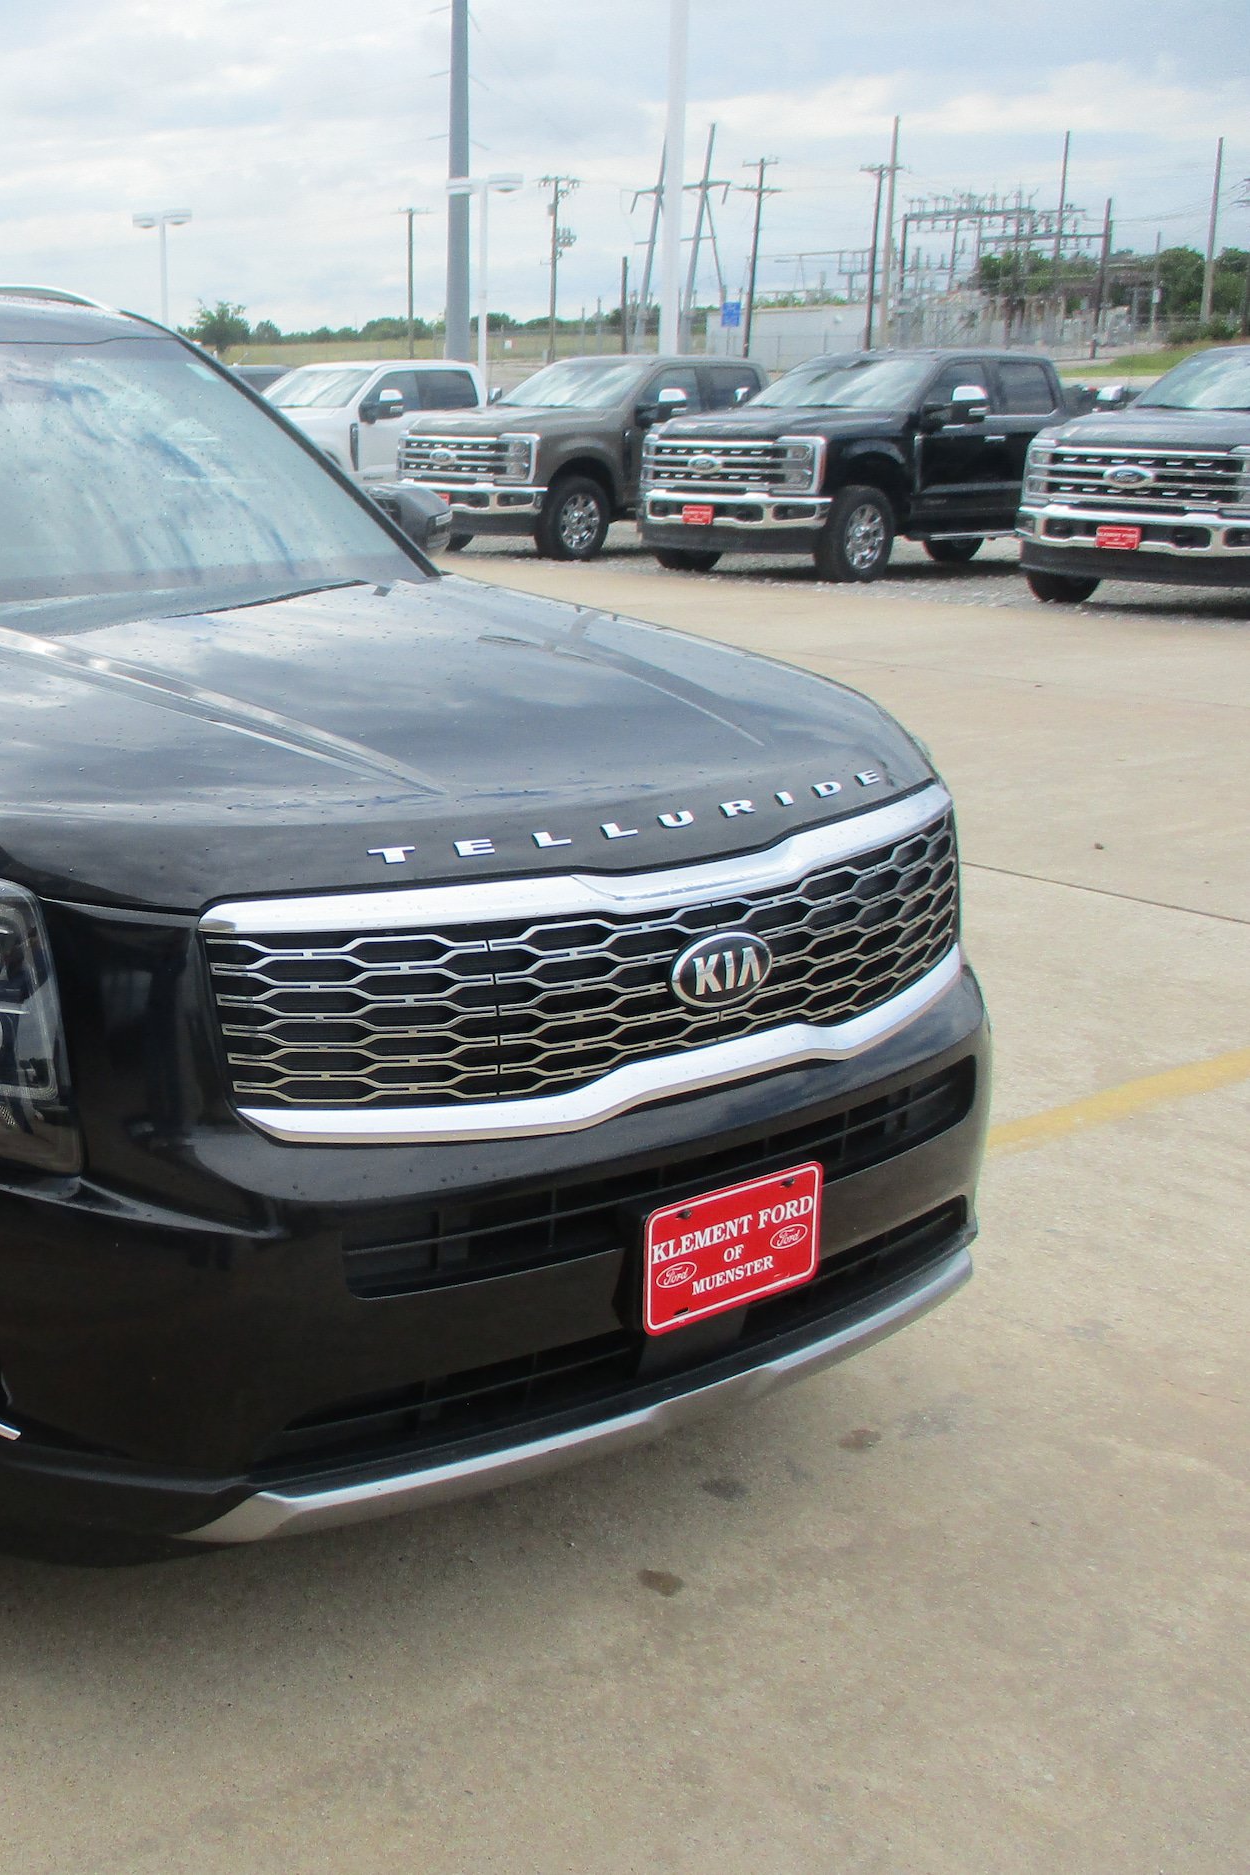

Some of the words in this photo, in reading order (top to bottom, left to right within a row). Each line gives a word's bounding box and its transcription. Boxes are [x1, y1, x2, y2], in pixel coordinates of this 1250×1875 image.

[367, 769, 882, 864] TELLURIDE
[692, 946, 761, 996] KIA
[652, 1214, 753, 1264] KLEMENT
[758, 1195, 814, 1229] FORD
[776, 1228, 801, 1247] Ford
[723, 1244, 745, 1262] OF
[663, 1266, 689, 1285] Ford
[691, 1255, 775, 1295] MUENSTER
